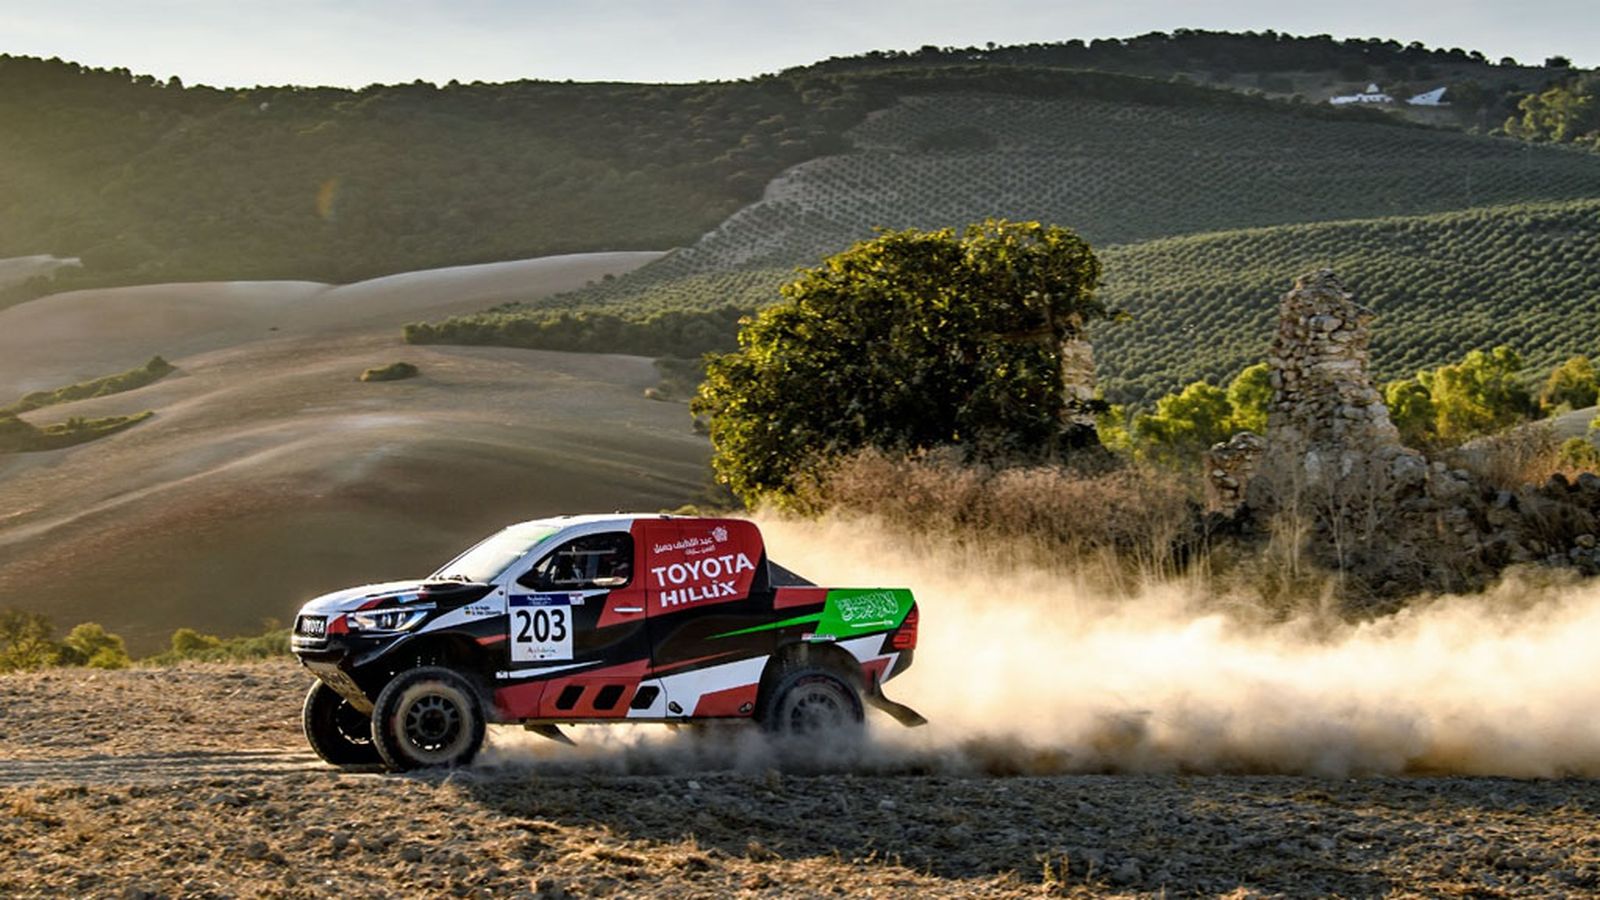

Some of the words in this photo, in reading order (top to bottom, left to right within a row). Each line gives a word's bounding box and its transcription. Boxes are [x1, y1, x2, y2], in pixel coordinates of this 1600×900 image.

[651, 552, 755, 587] TOYOTA
[660, 580, 737, 608] HILUX
[302, 617, 325, 633] TOYOTA
[516, 608, 567, 643] 203
